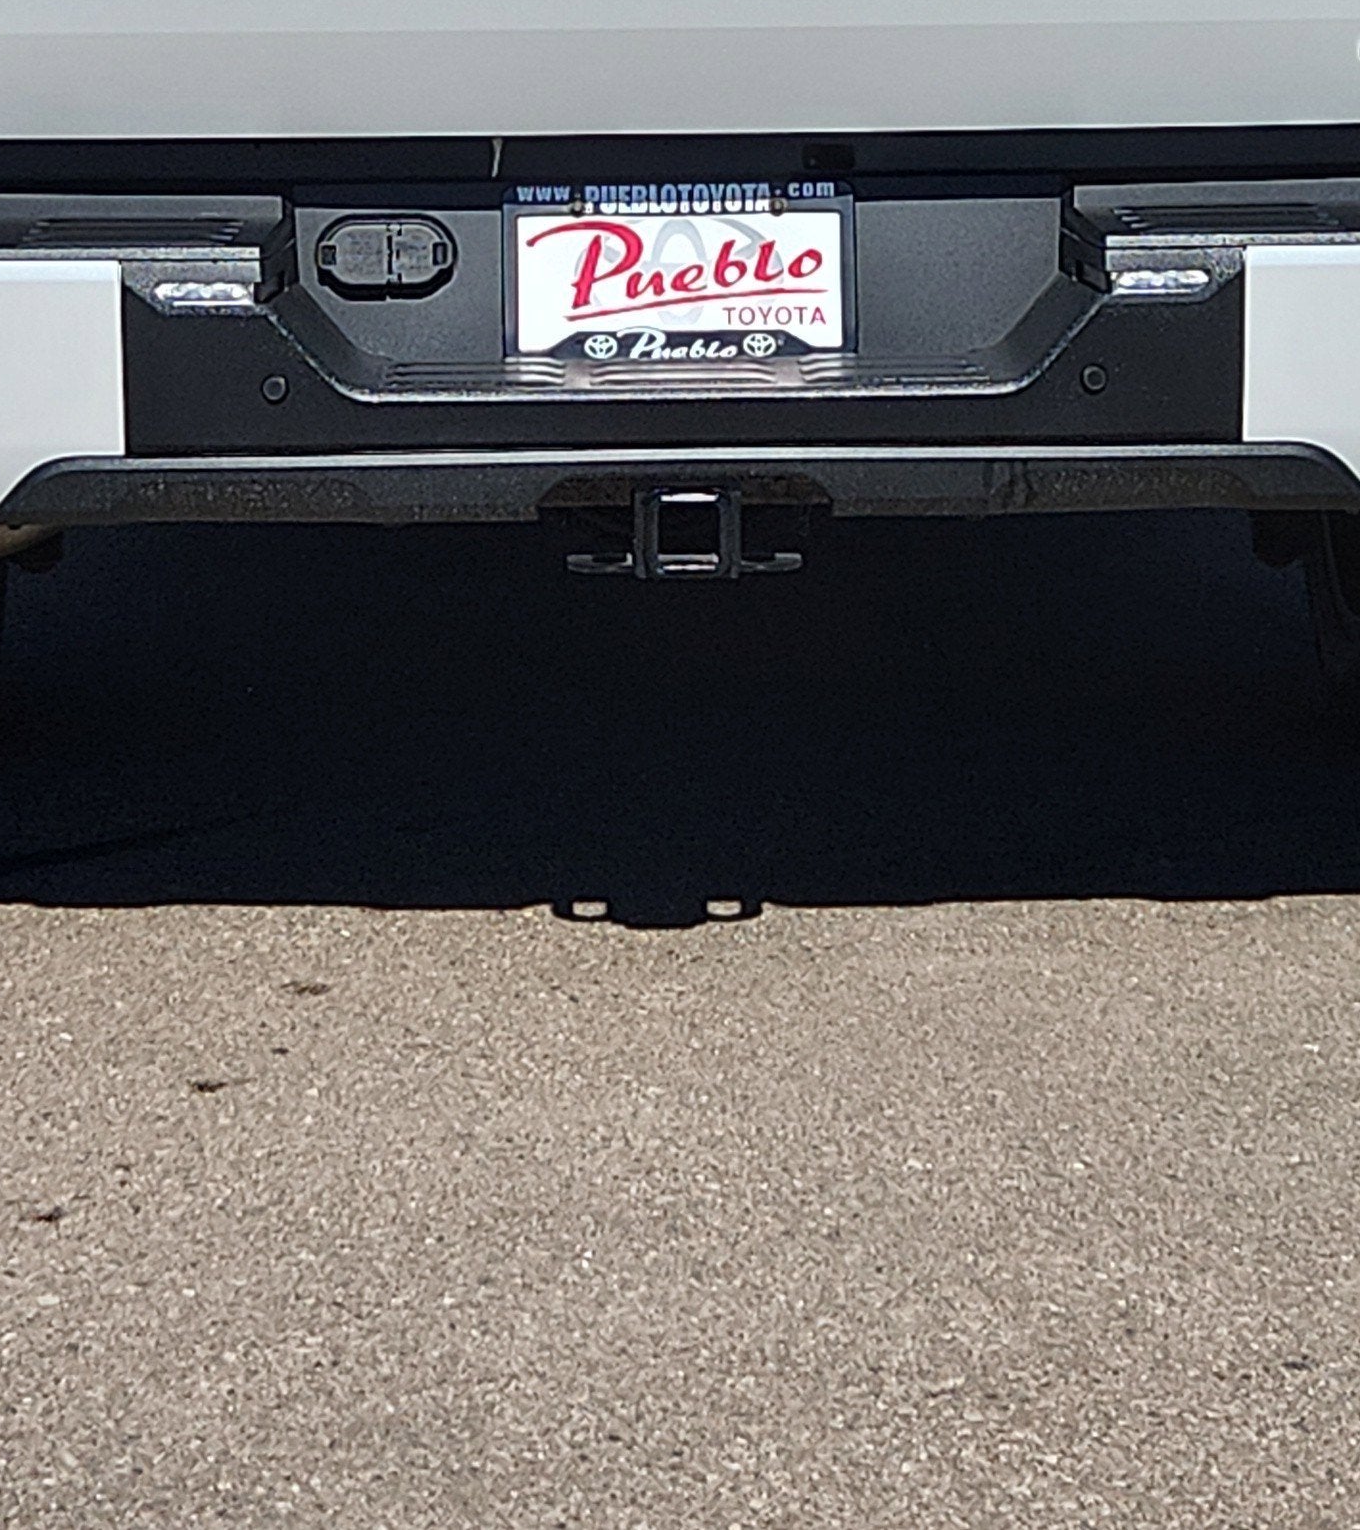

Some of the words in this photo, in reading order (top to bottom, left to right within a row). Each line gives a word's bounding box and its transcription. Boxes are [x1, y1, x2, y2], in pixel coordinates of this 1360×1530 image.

[526, 220, 824, 309] Pueblo
[722, 305, 827, 326] TOYOTA
[616, 326, 739, 360] Pueblo
